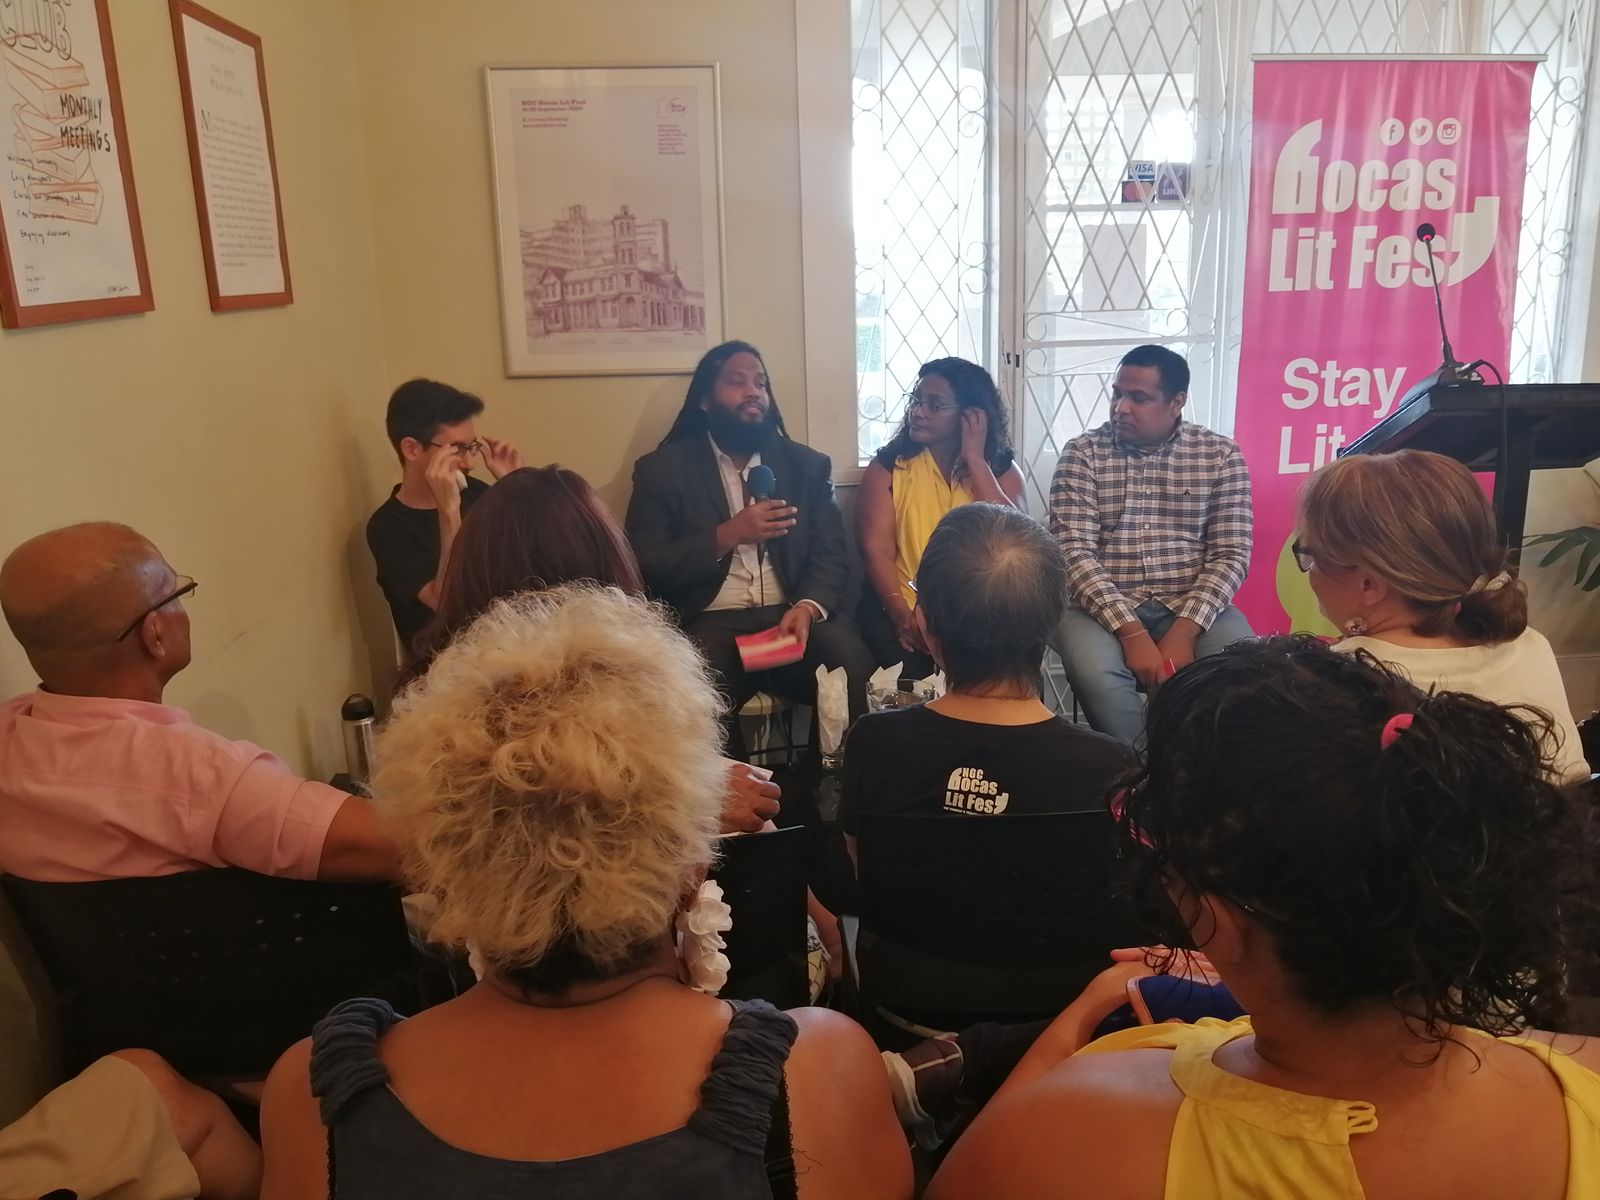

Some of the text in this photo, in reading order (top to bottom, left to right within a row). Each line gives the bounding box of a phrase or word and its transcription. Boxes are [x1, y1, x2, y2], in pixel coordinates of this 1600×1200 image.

[60, 93, 102, 124] MONTHLY
[60, 125, 111, 152] MEETINGS
[1268, 228, 1335, 292] Lit
[1281, 357, 1408, 419] Stay
[1278, 423, 1347, 475] Lit
[962, 767, 984, 780] NGC
[944, 791, 965, 808] Lit
